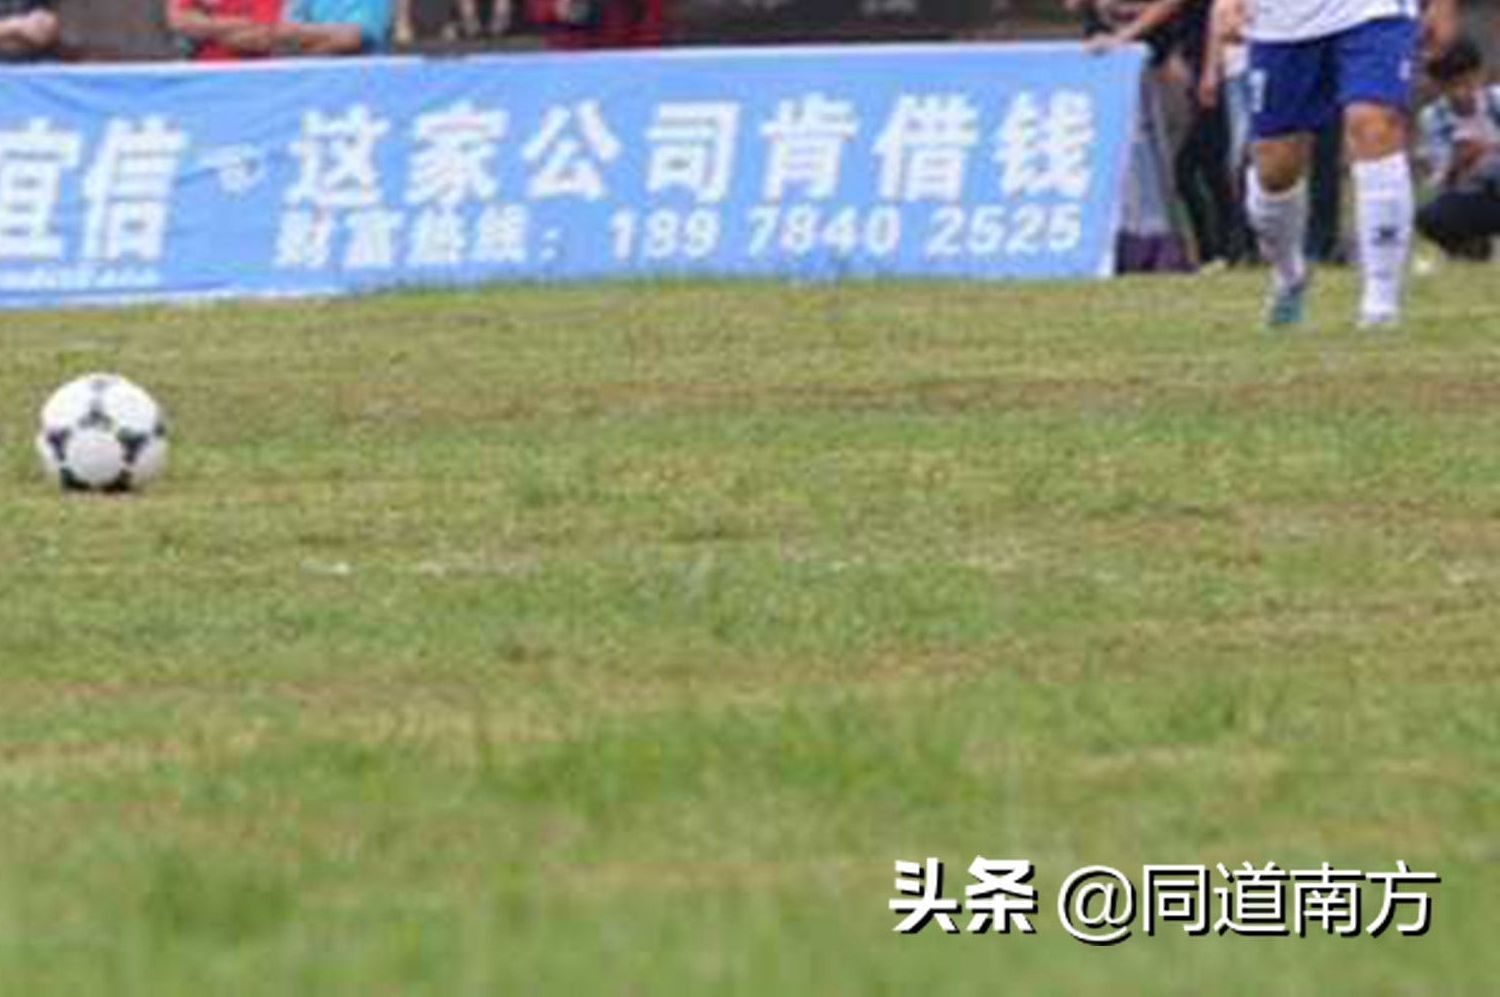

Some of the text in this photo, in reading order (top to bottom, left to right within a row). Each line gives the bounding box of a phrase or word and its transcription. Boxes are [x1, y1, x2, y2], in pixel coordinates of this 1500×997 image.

[280, 92, 1096, 206] 这家公司肯借钱
[926, 202, 1081, 258] 2525
